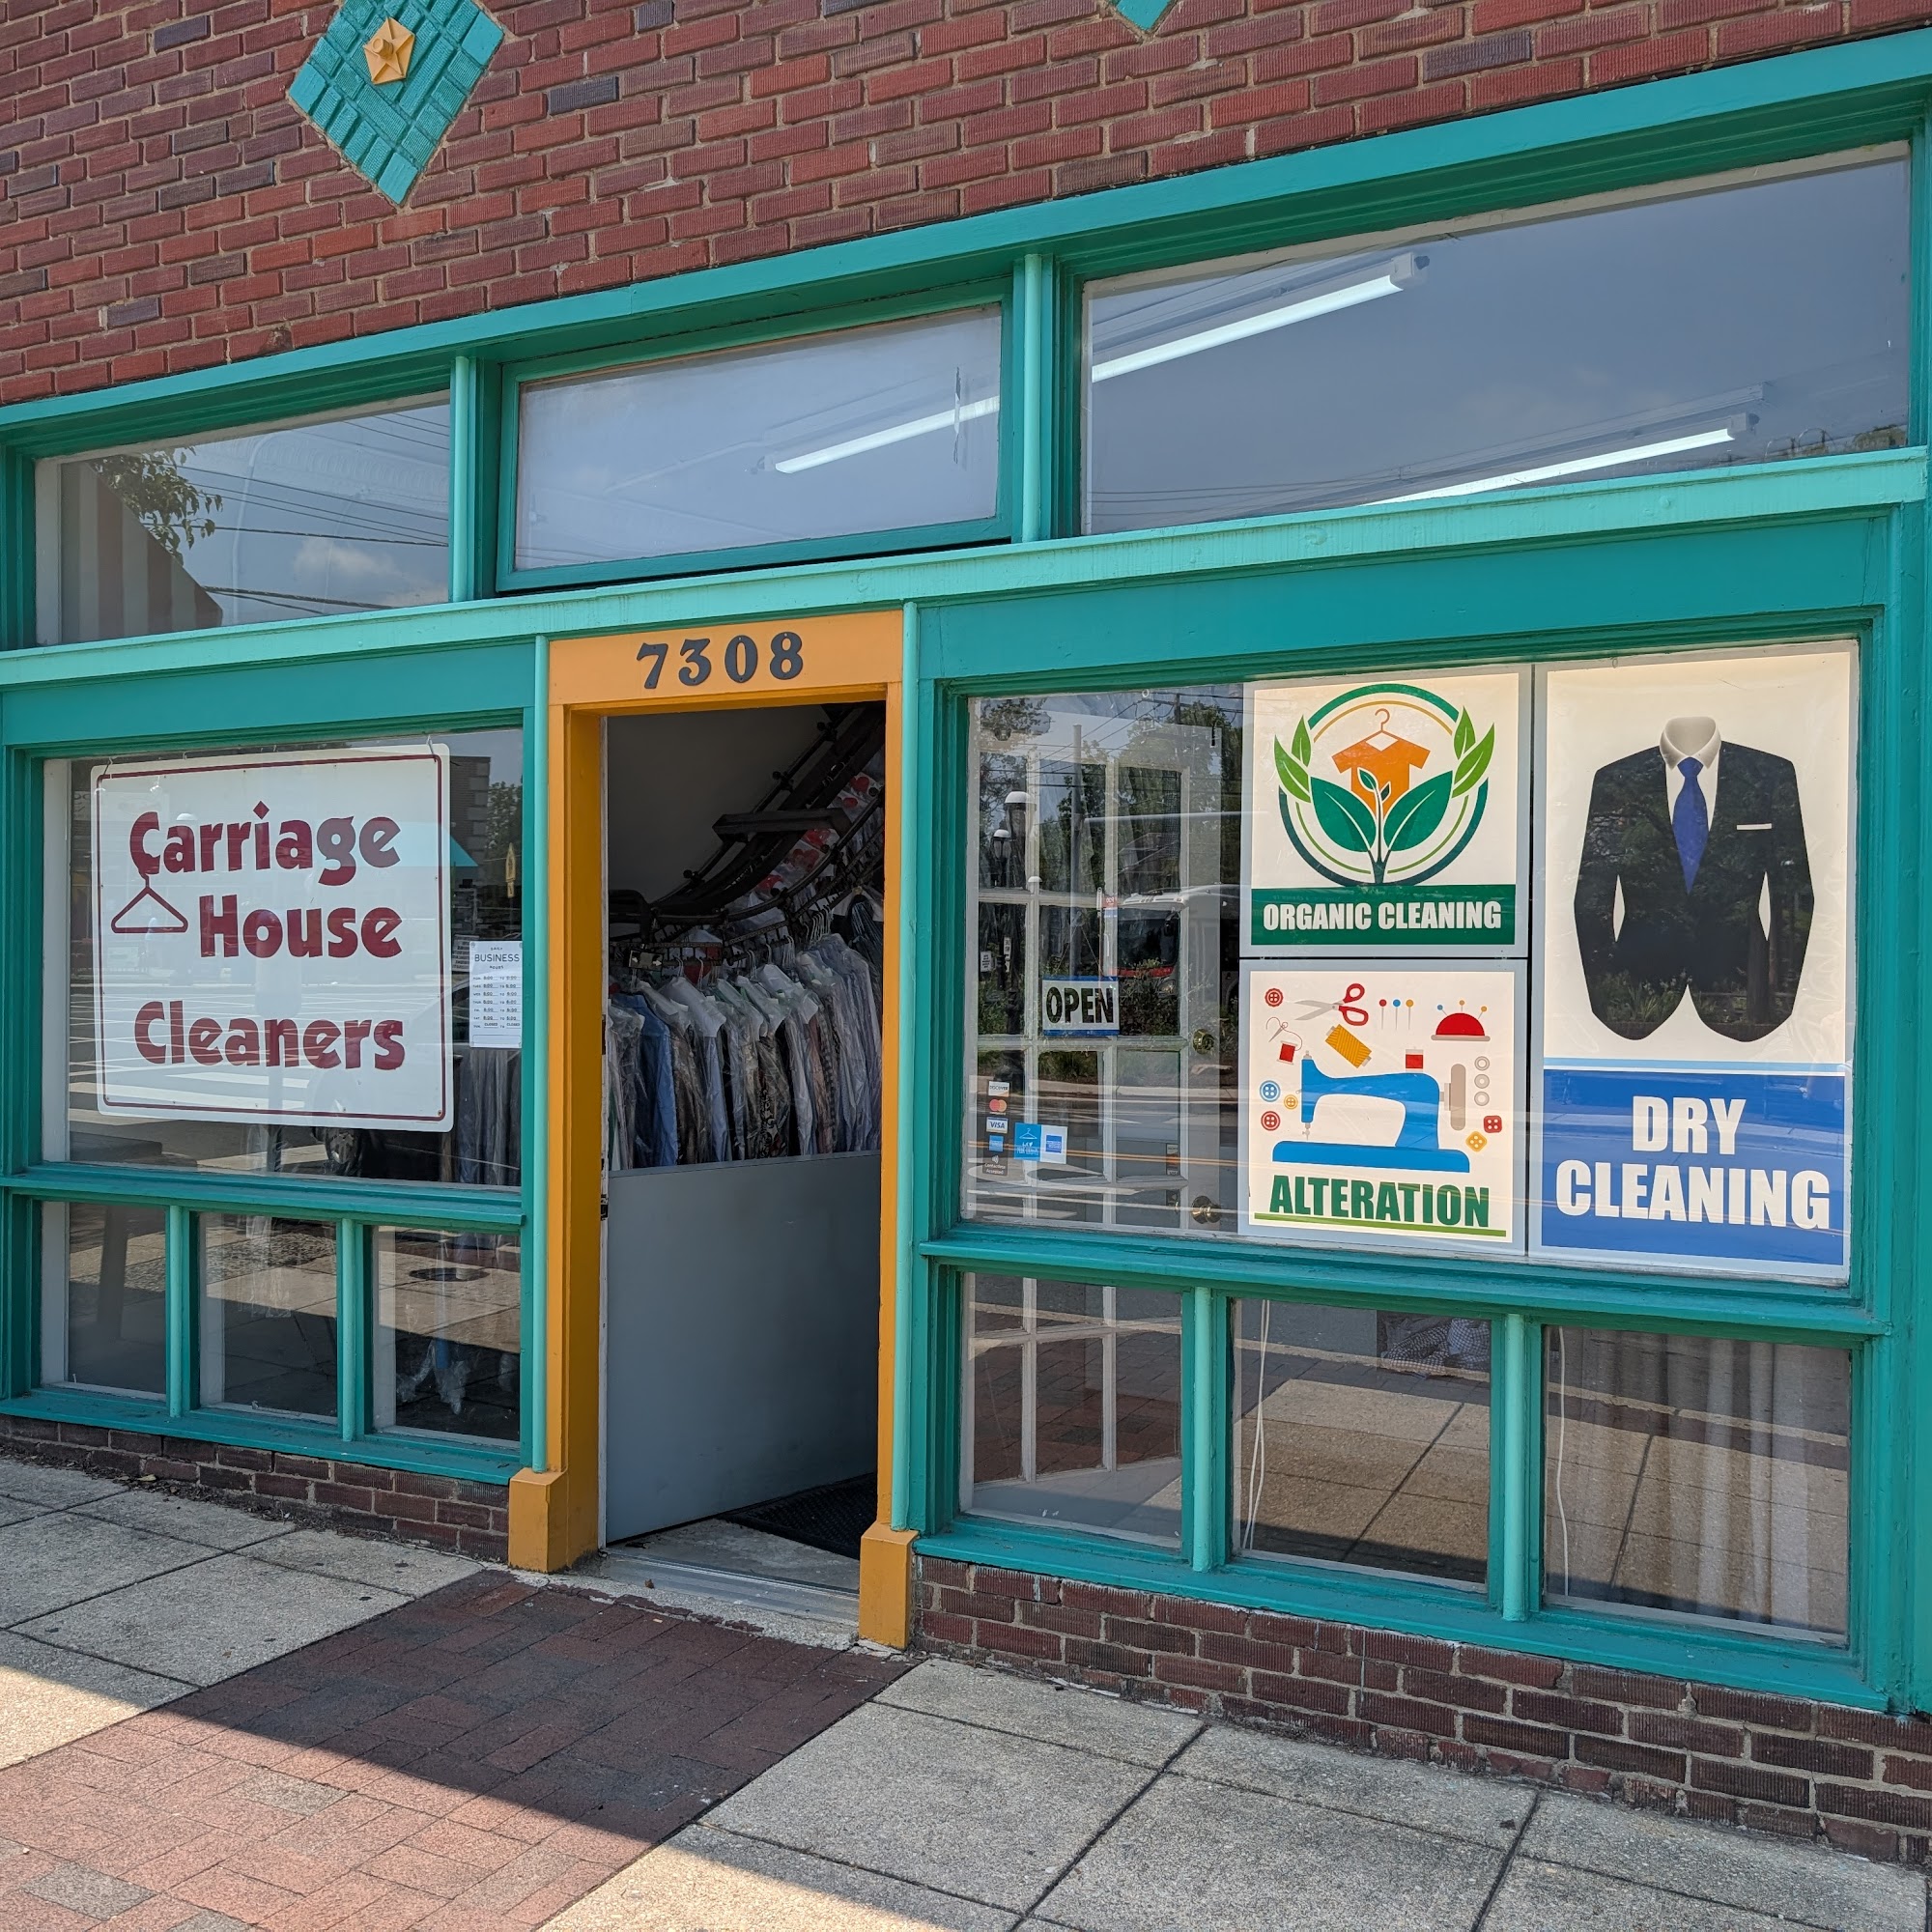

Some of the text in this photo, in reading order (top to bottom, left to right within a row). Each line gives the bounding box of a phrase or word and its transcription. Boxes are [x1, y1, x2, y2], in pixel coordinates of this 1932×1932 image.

[637, 632, 804, 689] 7308
[129, 800, 402, 887] Carriage
[199, 894, 403, 958] House
[1264, 901, 1501, 930] ORGANIC CLEANING
[474, 953, 521, 962] BUSINESS
[1046, 986, 1114, 1024] OPEN
[134, 1001, 406, 1070] Cleaners
[989, 1121, 1006, 1129] VISA
[1632, 1095, 1746, 1155] DRY
[1269, 1175, 1491, 1228] ALTERATION
[1556, 1160, 1831, 1230] CLEANING
